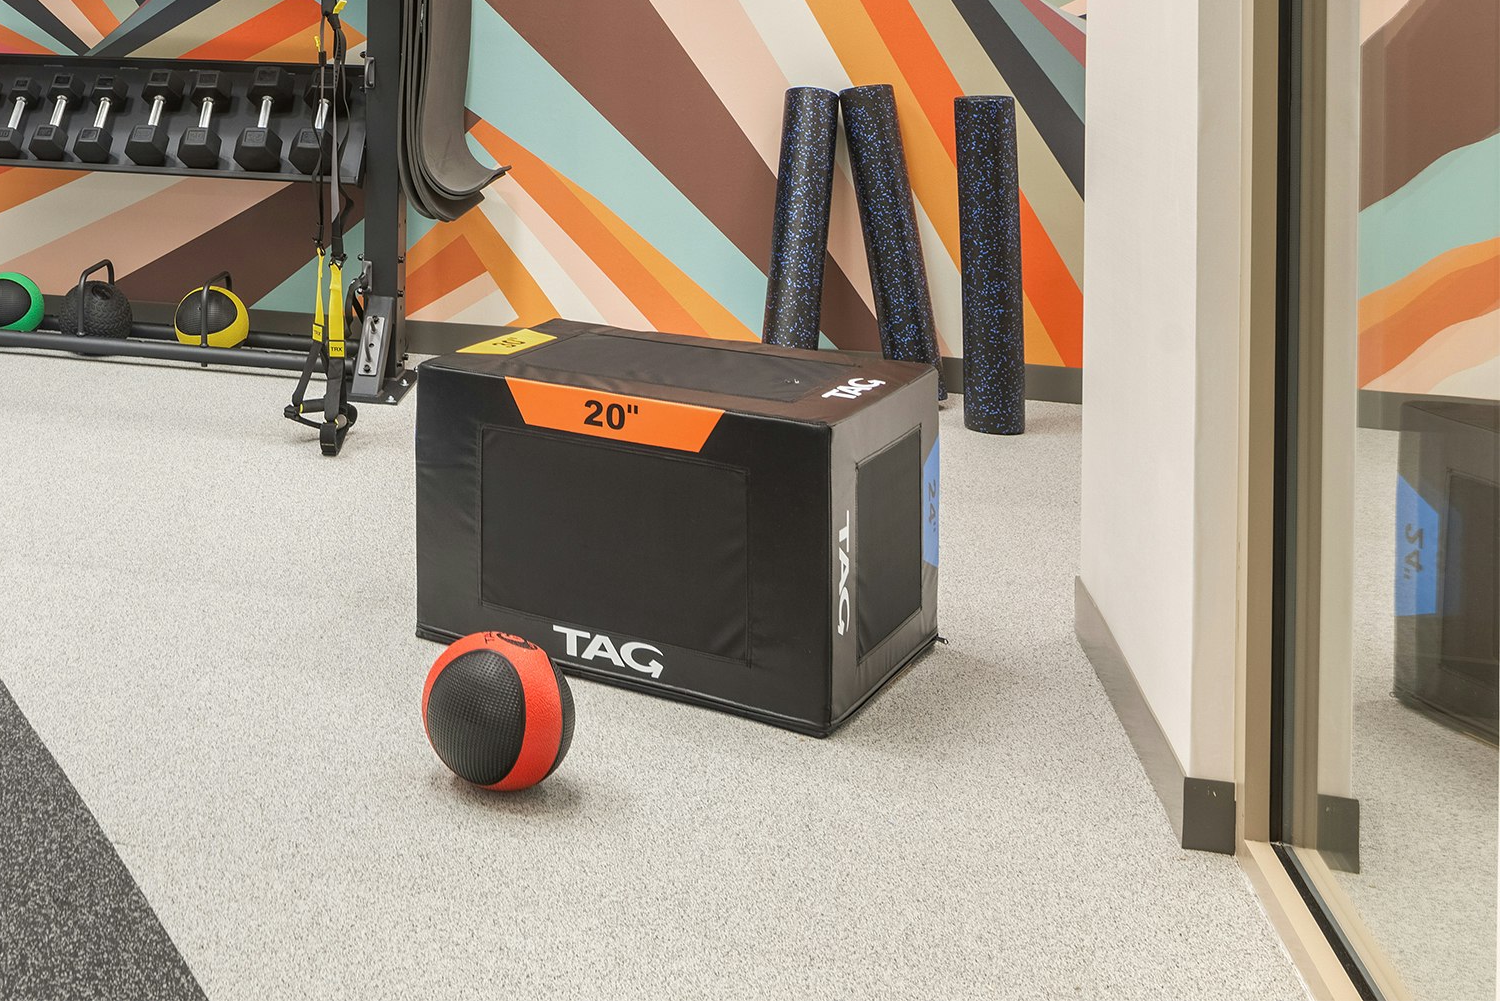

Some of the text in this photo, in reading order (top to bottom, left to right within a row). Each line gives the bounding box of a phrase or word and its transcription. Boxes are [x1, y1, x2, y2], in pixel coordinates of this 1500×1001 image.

[821, 377, 887, 400] TAG
[583, 399, 639, 431] 20"
[837, 509, 850, 636] TAG
[552, 624, 665, 679] TAG
